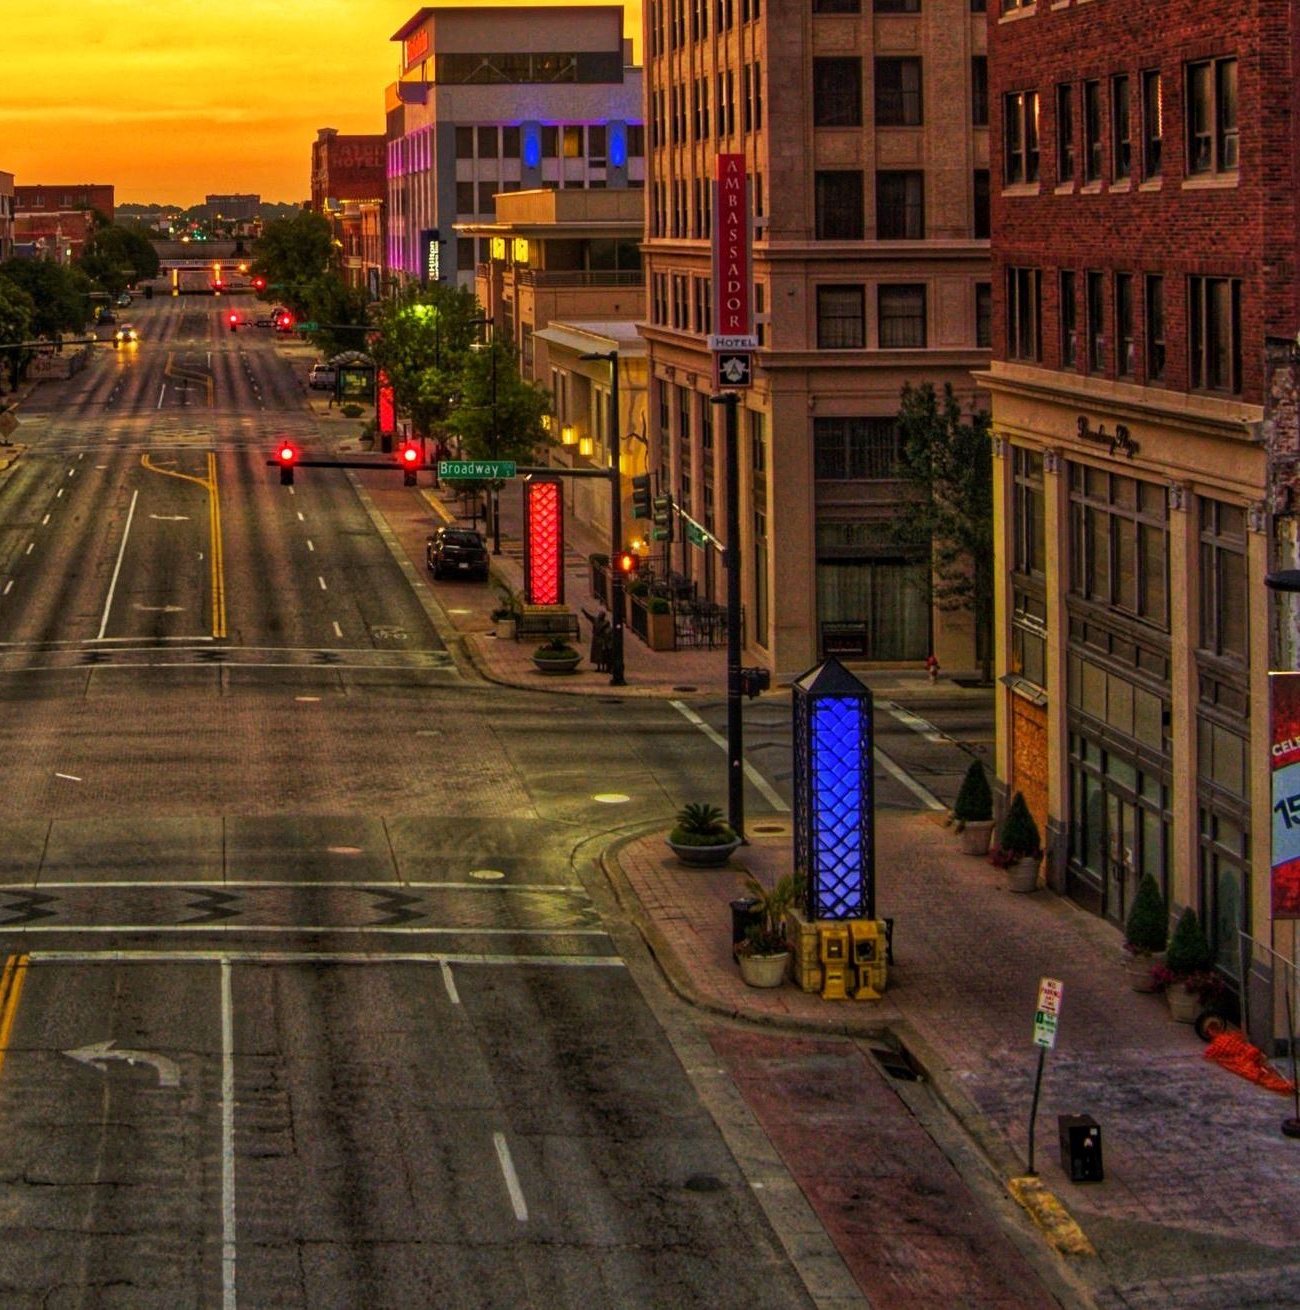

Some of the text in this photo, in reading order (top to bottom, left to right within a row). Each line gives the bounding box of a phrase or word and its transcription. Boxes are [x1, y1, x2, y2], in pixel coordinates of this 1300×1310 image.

[333, 157, 383, 167] HOTEL
[725, 161, 740, 327] AMBASSADOR
[715, 337, 755, 348] HOTEL
[440, 462, 499, 478] Broadway
